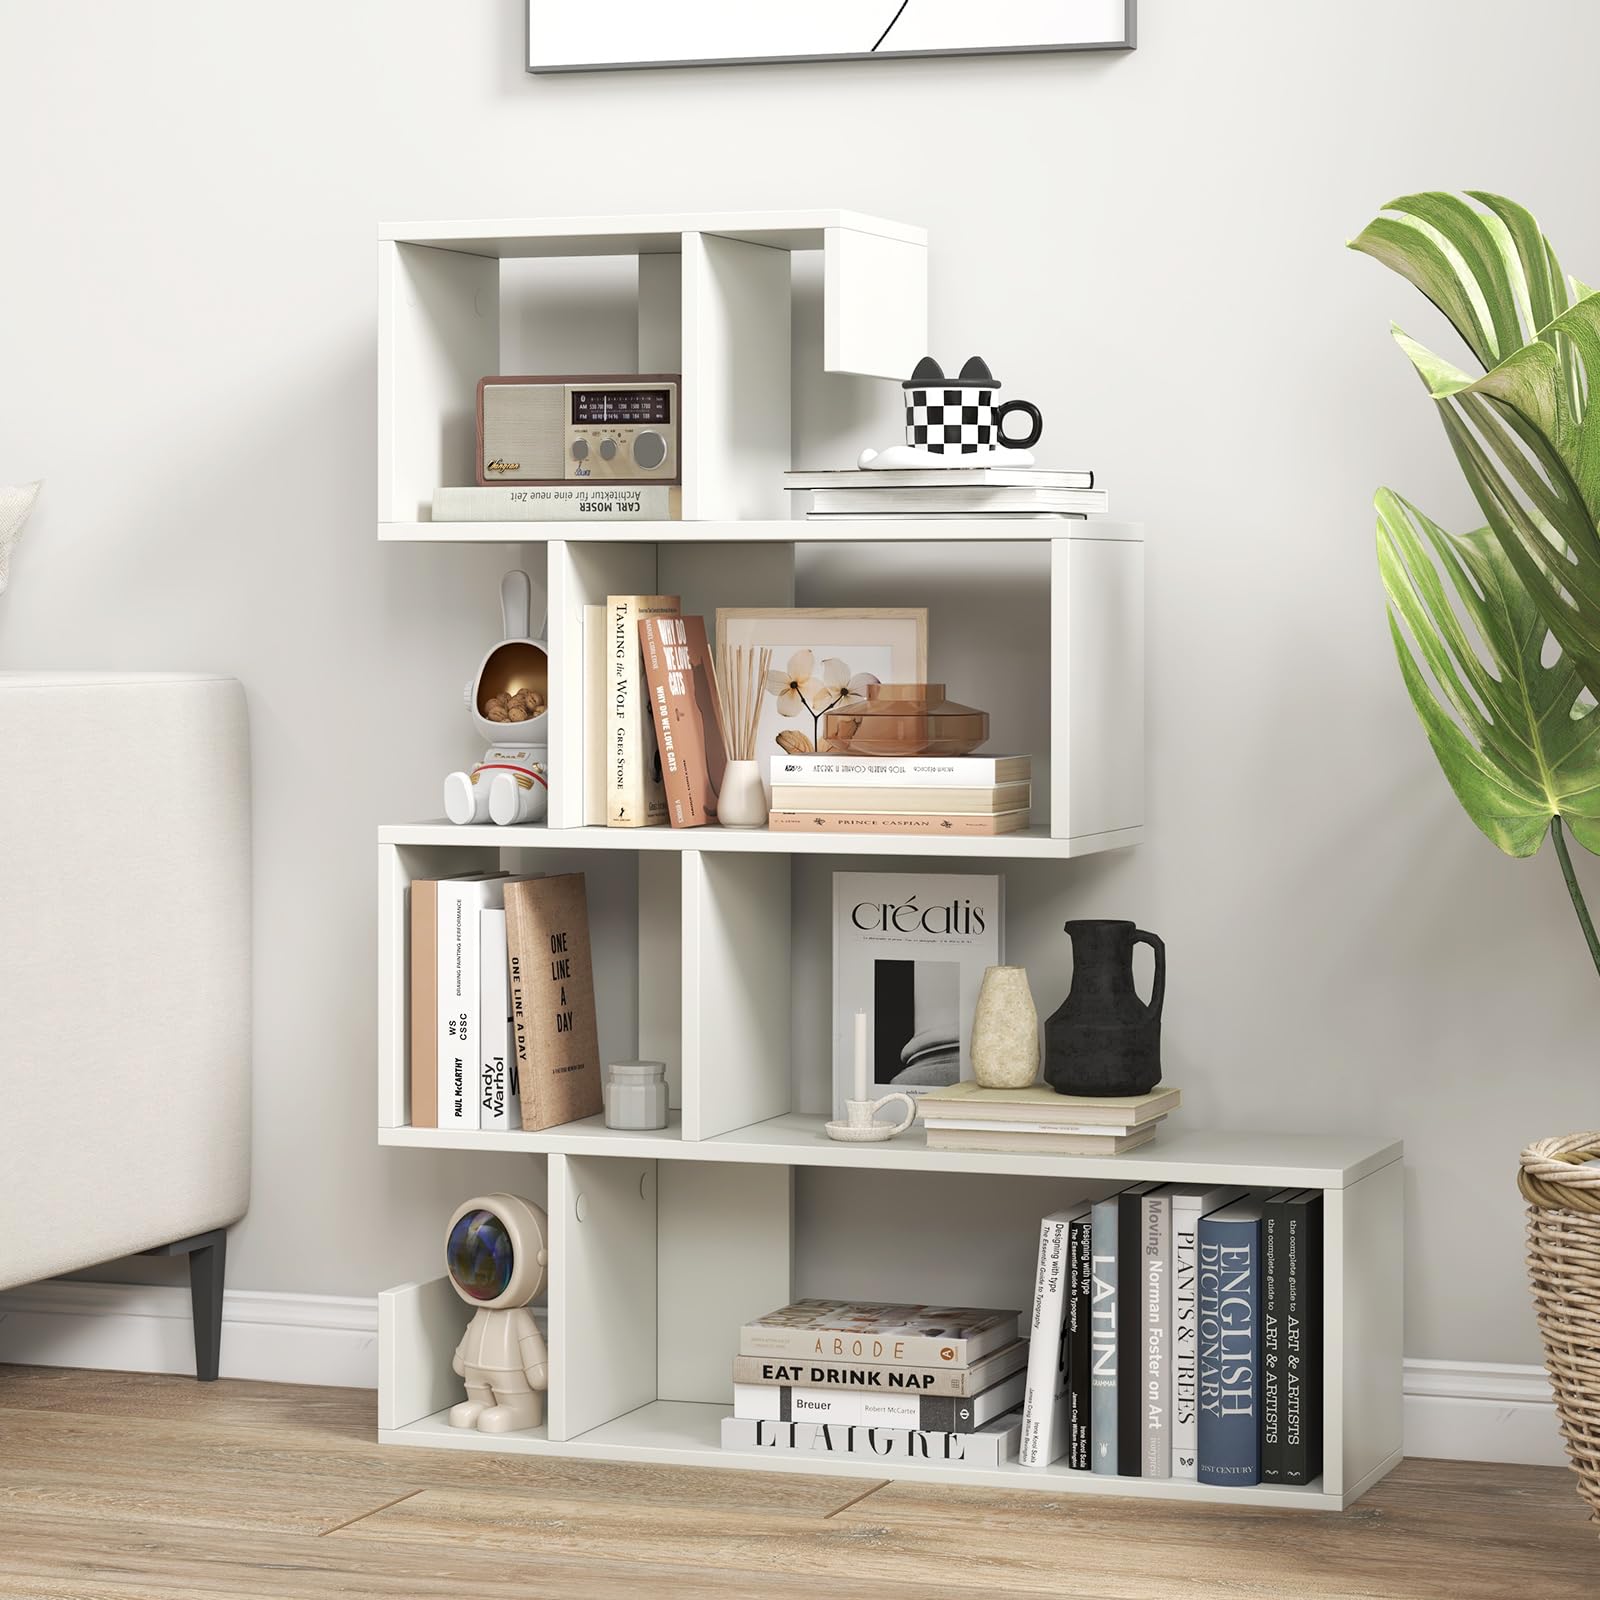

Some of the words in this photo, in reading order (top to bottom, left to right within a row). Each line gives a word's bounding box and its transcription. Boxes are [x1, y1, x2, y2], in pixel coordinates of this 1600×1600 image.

[511, 492, 527, 502] Zeit
[530, 492, 552, 501] neue
[555, 492, 573, 501] eine
[576, 492, 588, 502] für
[580, 502, 612, 512] MOSER
[591, 490, 641, 502] Architektur
[616, 502, 640, 512] CARL
[616, 603, 628, 658] TAMING
[616, 662, 627, 677] the
[616, 680, 628, 719] WOLF
[656, 686, 666, 703] WHY
[659, 706, 668, 716] DO
[661, 718, 670, 730] WE
[616, 728, 626, 756] GREG
[663, 732, 673, 751] LOVE
[666, 752, 677, 772] CATS
[616, 758, 626, 790] STONE
[852, 895, 986, 935] créatis
[550, 932, 567, 954] ONE
[512, 957, 520, 982] ONE
[552, 958, 570, 981] LINE
[515, 989, 524, 1017] LINE
[560, 986, 567, 1006] A
[449, 1020, 456, 1035] WS
[459, 1013, 467, 1040] CSSC
[557, 1012, 573, 1033] DAY
[518, 1034, 527, 1061] DAY
[454, 1058, 463, 1096] McCARTHY
[482, 1064, 495, 1110] Andy
[493, 1057, 504, 1117] Warhol
[455, 1098, 463, 1117] PAUL
[1146, 1200, 1162, 1256] Moving
[1051, 1224, 1064, 1259] Designing
[1081, 1224, 1091, 1261] Designing
[1266, 1234, 1275, 1273] complete
[1288, 1236, 1297, 1275] complete
[1051, 1261, 1060, 1276] with
[1177, 1232, 1195, 1320] PLANTS
[1048, 1277, 1058, 1293] type
[1081, 1279, 1091, 1294] type
[1149, 1260, 1163, 1322] Norman
[1266, 1276, 1275, 1299] guide
[1288, 1276, 1297, 1300] guide
[1034, 1294, 1043, 1329] Typography
[1092, 1255, 1116, 1376] LATIN
[1267, 1300, 1274, 1310] to
[1290, 1301, 1297, 1312] to
[1177, 1326, 1195, 1343] &
[1200, 1243, 1220, 1418] DICTIONARY
[1220, 1243, 1253, 1417] ENGLISH
[1266, 1314, 1278, 1350] ART
[1288, 1315, 1300, 1351] ART
[814, 1338, 905, 1360] ABODE
[1148, 1328, 1163, 1376] Foster
[1266, 1354, 1278, 1368] &
[1288, 1355, 1300, 1369] &
[762, 1365, 803, 1380] EAT
[810, 1368, 881, 1386] DRINK
[888, 1372, 935, 1389] NAP
[1177, 1347, 1195, 1424] TREES
[1149, 1381, 1159, 1398] on
[796, 1399, 831, 1411] Breuer
[864, 1404, 886, 1413] Robert
[887, 1406, 916, 1416] McCarter
[1149, 1404, 1163, 1429] Art
[1266, 1371, 1278, 1443] ARTISTS
[1288, 1372, 1300, 1445] ARTISTS
[1216, 1466, 1254, 1474] CENTURY
